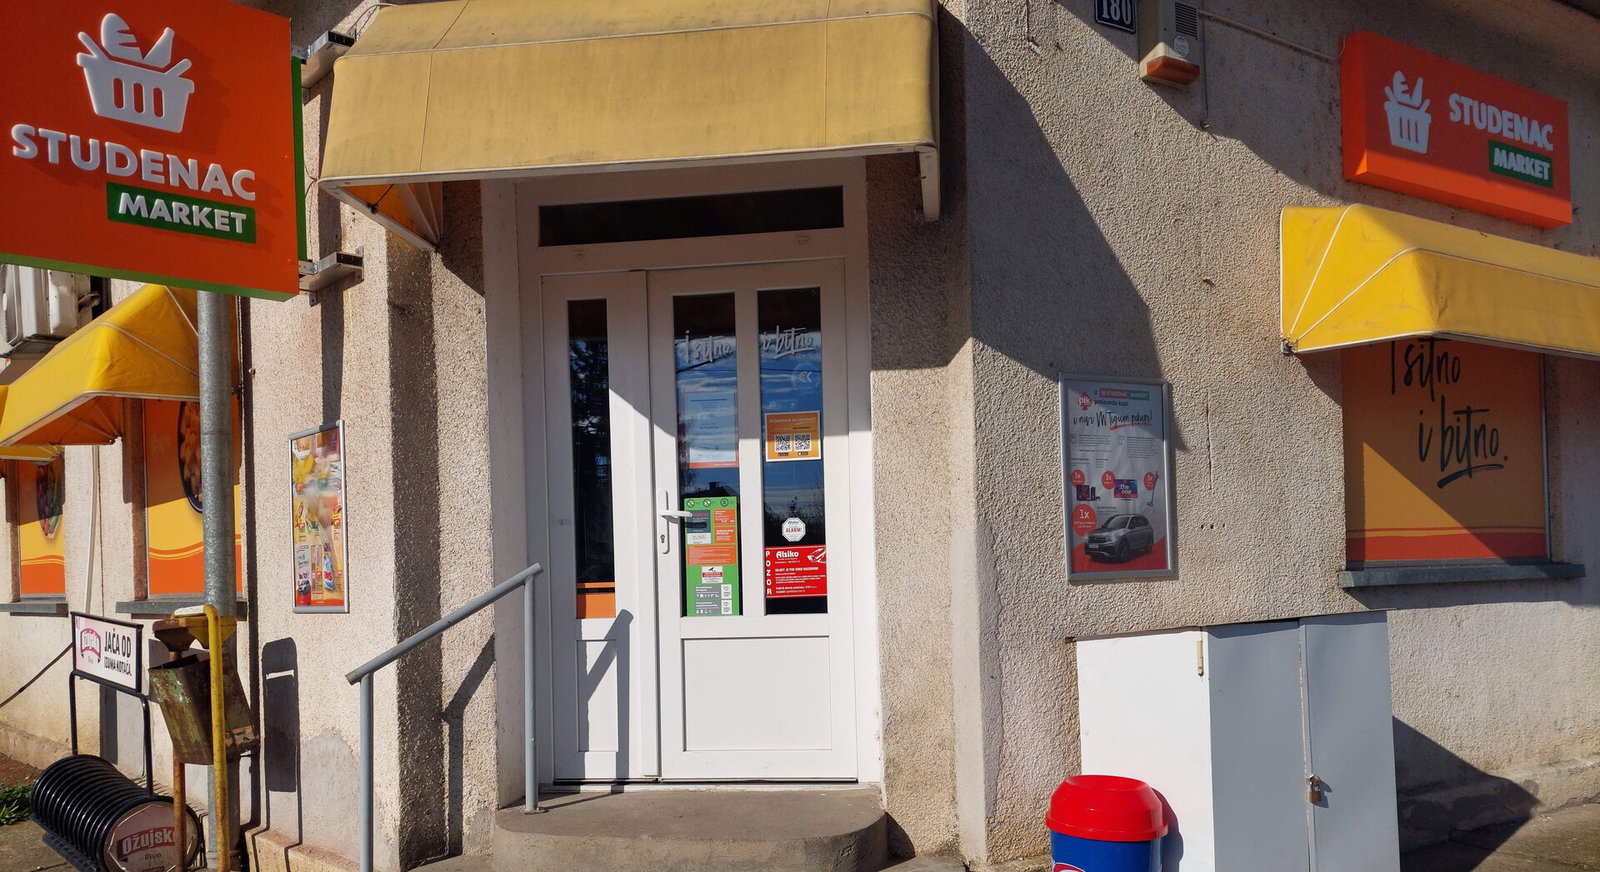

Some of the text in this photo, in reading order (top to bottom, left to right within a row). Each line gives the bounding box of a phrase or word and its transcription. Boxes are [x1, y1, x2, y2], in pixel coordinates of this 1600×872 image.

[1102, 0, 1132, 25] 180
[1449, 93, 1554, 151] STUDENAC
[11, 123, 256, 201] STUDENAC
[1494, 147, 1550, 181] MARKET
[118, 192, 247, 234] MARKET
[1403, 337, 1461, 402] sitno
[1419, 409, 1433, 462] i
[1079, 509, 1089, 519] 1x
[776, 550, 799, 559] Alsiko
[104, 628, 121, 655] JAČA
[121, 634, 132, 658] OD
[122, 828, 176, 855] Ožujsk
